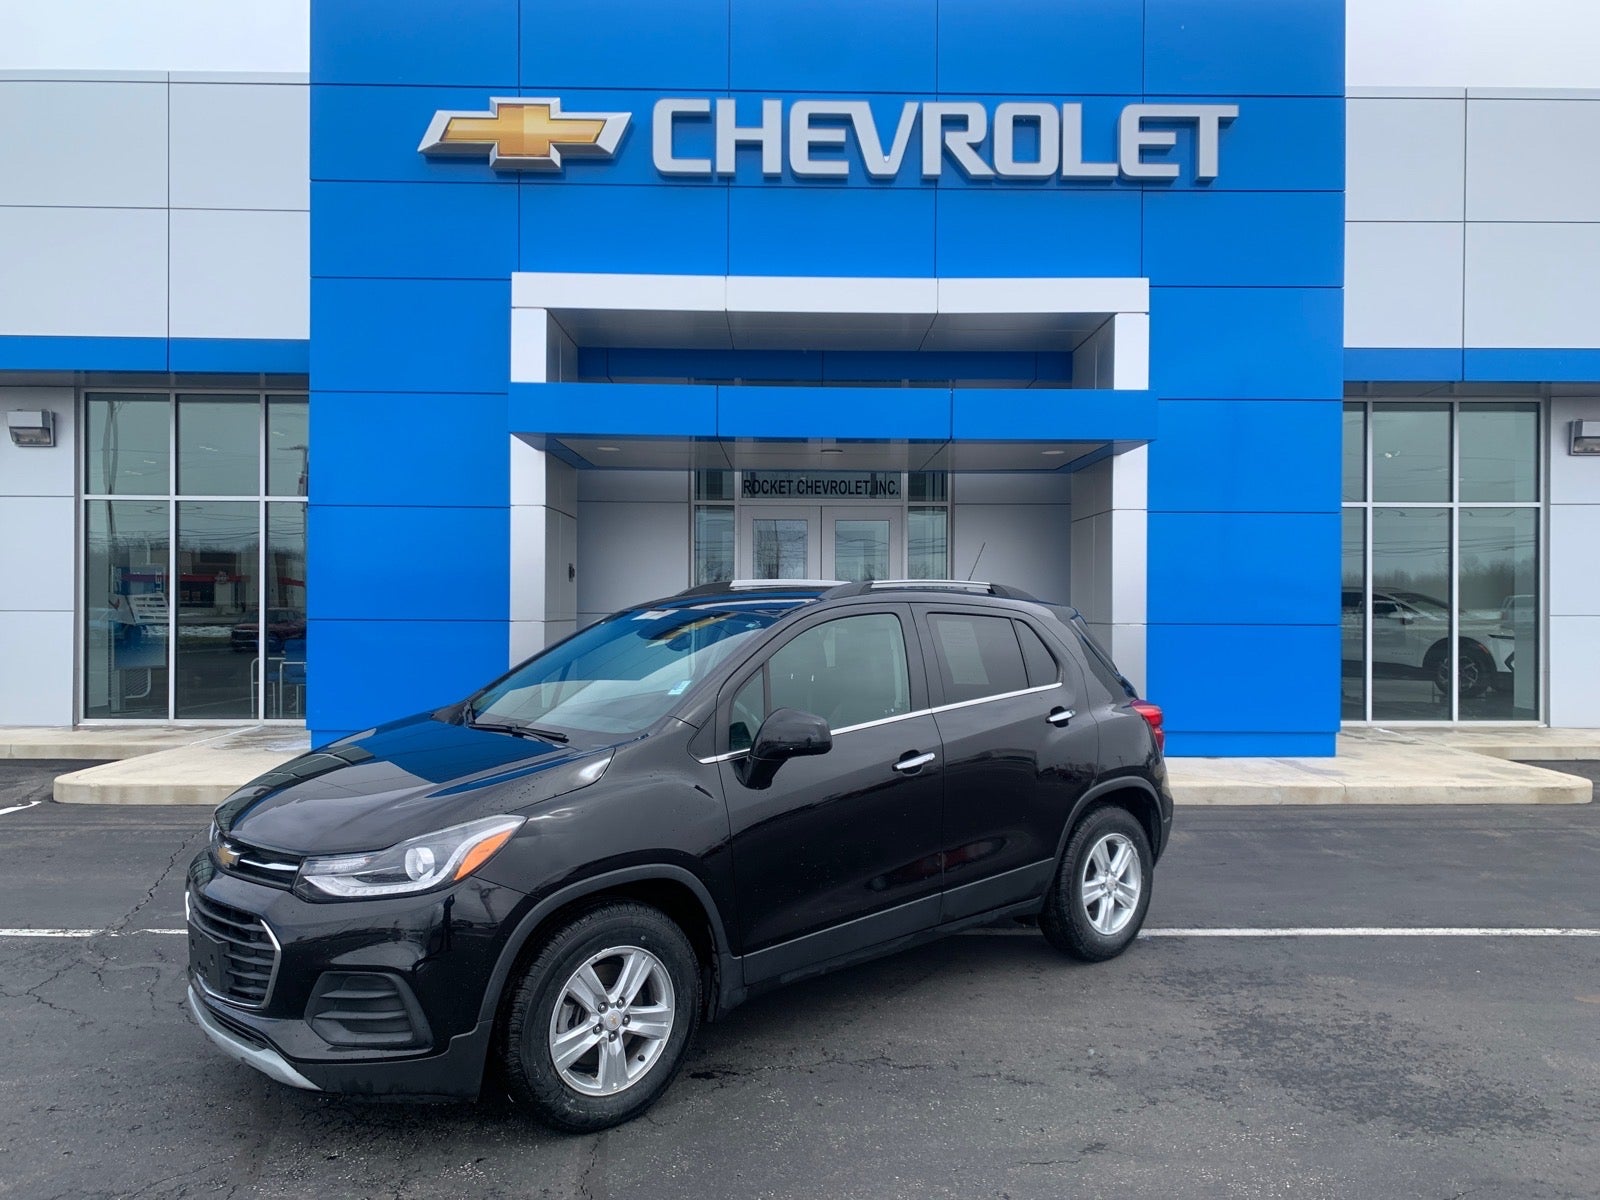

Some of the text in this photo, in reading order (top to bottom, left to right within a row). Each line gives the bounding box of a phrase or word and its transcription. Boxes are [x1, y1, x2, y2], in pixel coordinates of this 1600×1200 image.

[652, 98, 1239, 181] CHEVROLET
[743, 479, 793, 495] ROCKET
[875, 479, 899, 495] INC.
